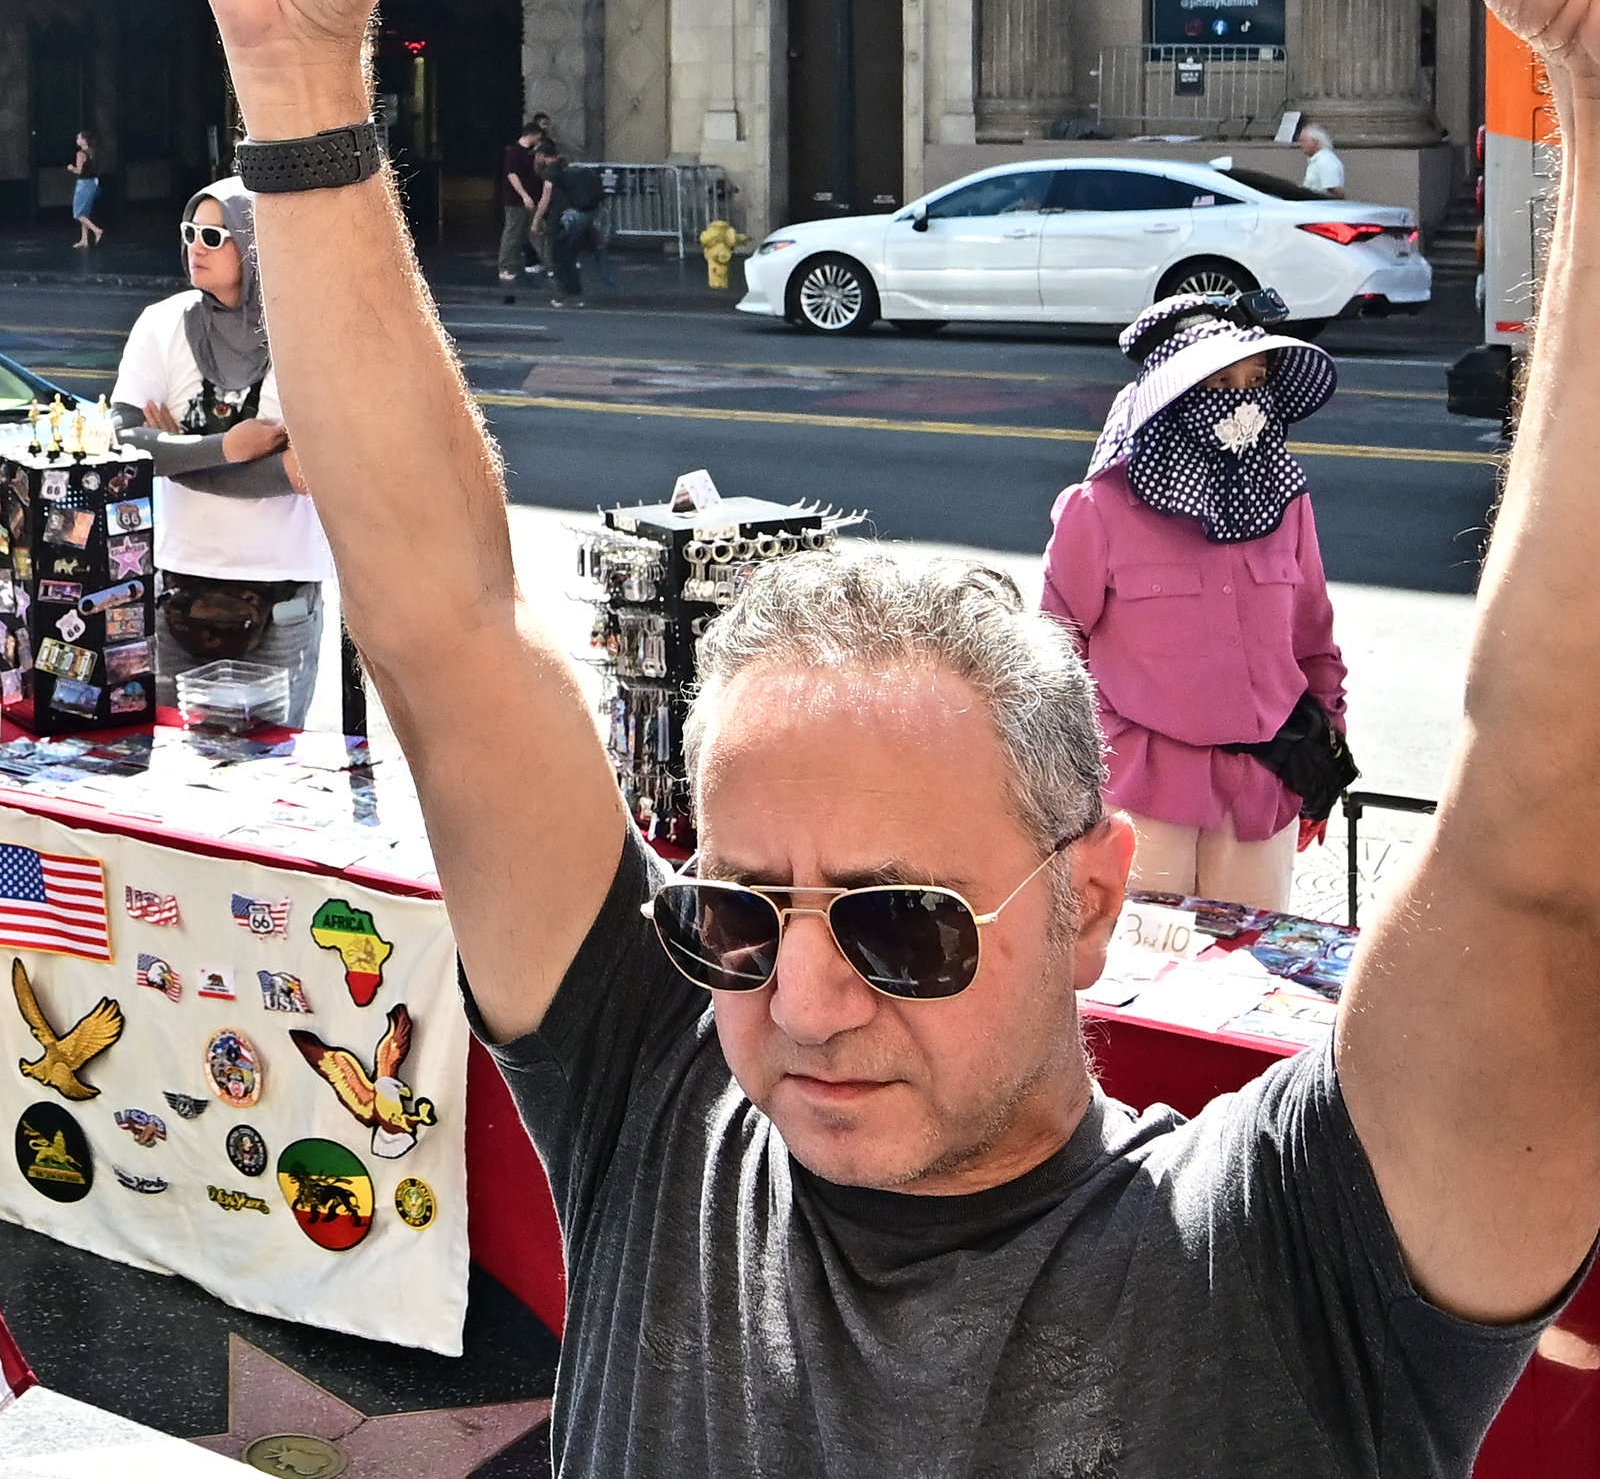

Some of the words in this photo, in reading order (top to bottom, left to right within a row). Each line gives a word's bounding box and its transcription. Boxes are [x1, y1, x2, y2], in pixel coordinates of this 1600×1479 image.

[124, 884, 179, 929] USA
[252, 914, 271, 929] 66
[322, 913, 366, 932] AFRICA
[265, 994, 306, 1013] USA
